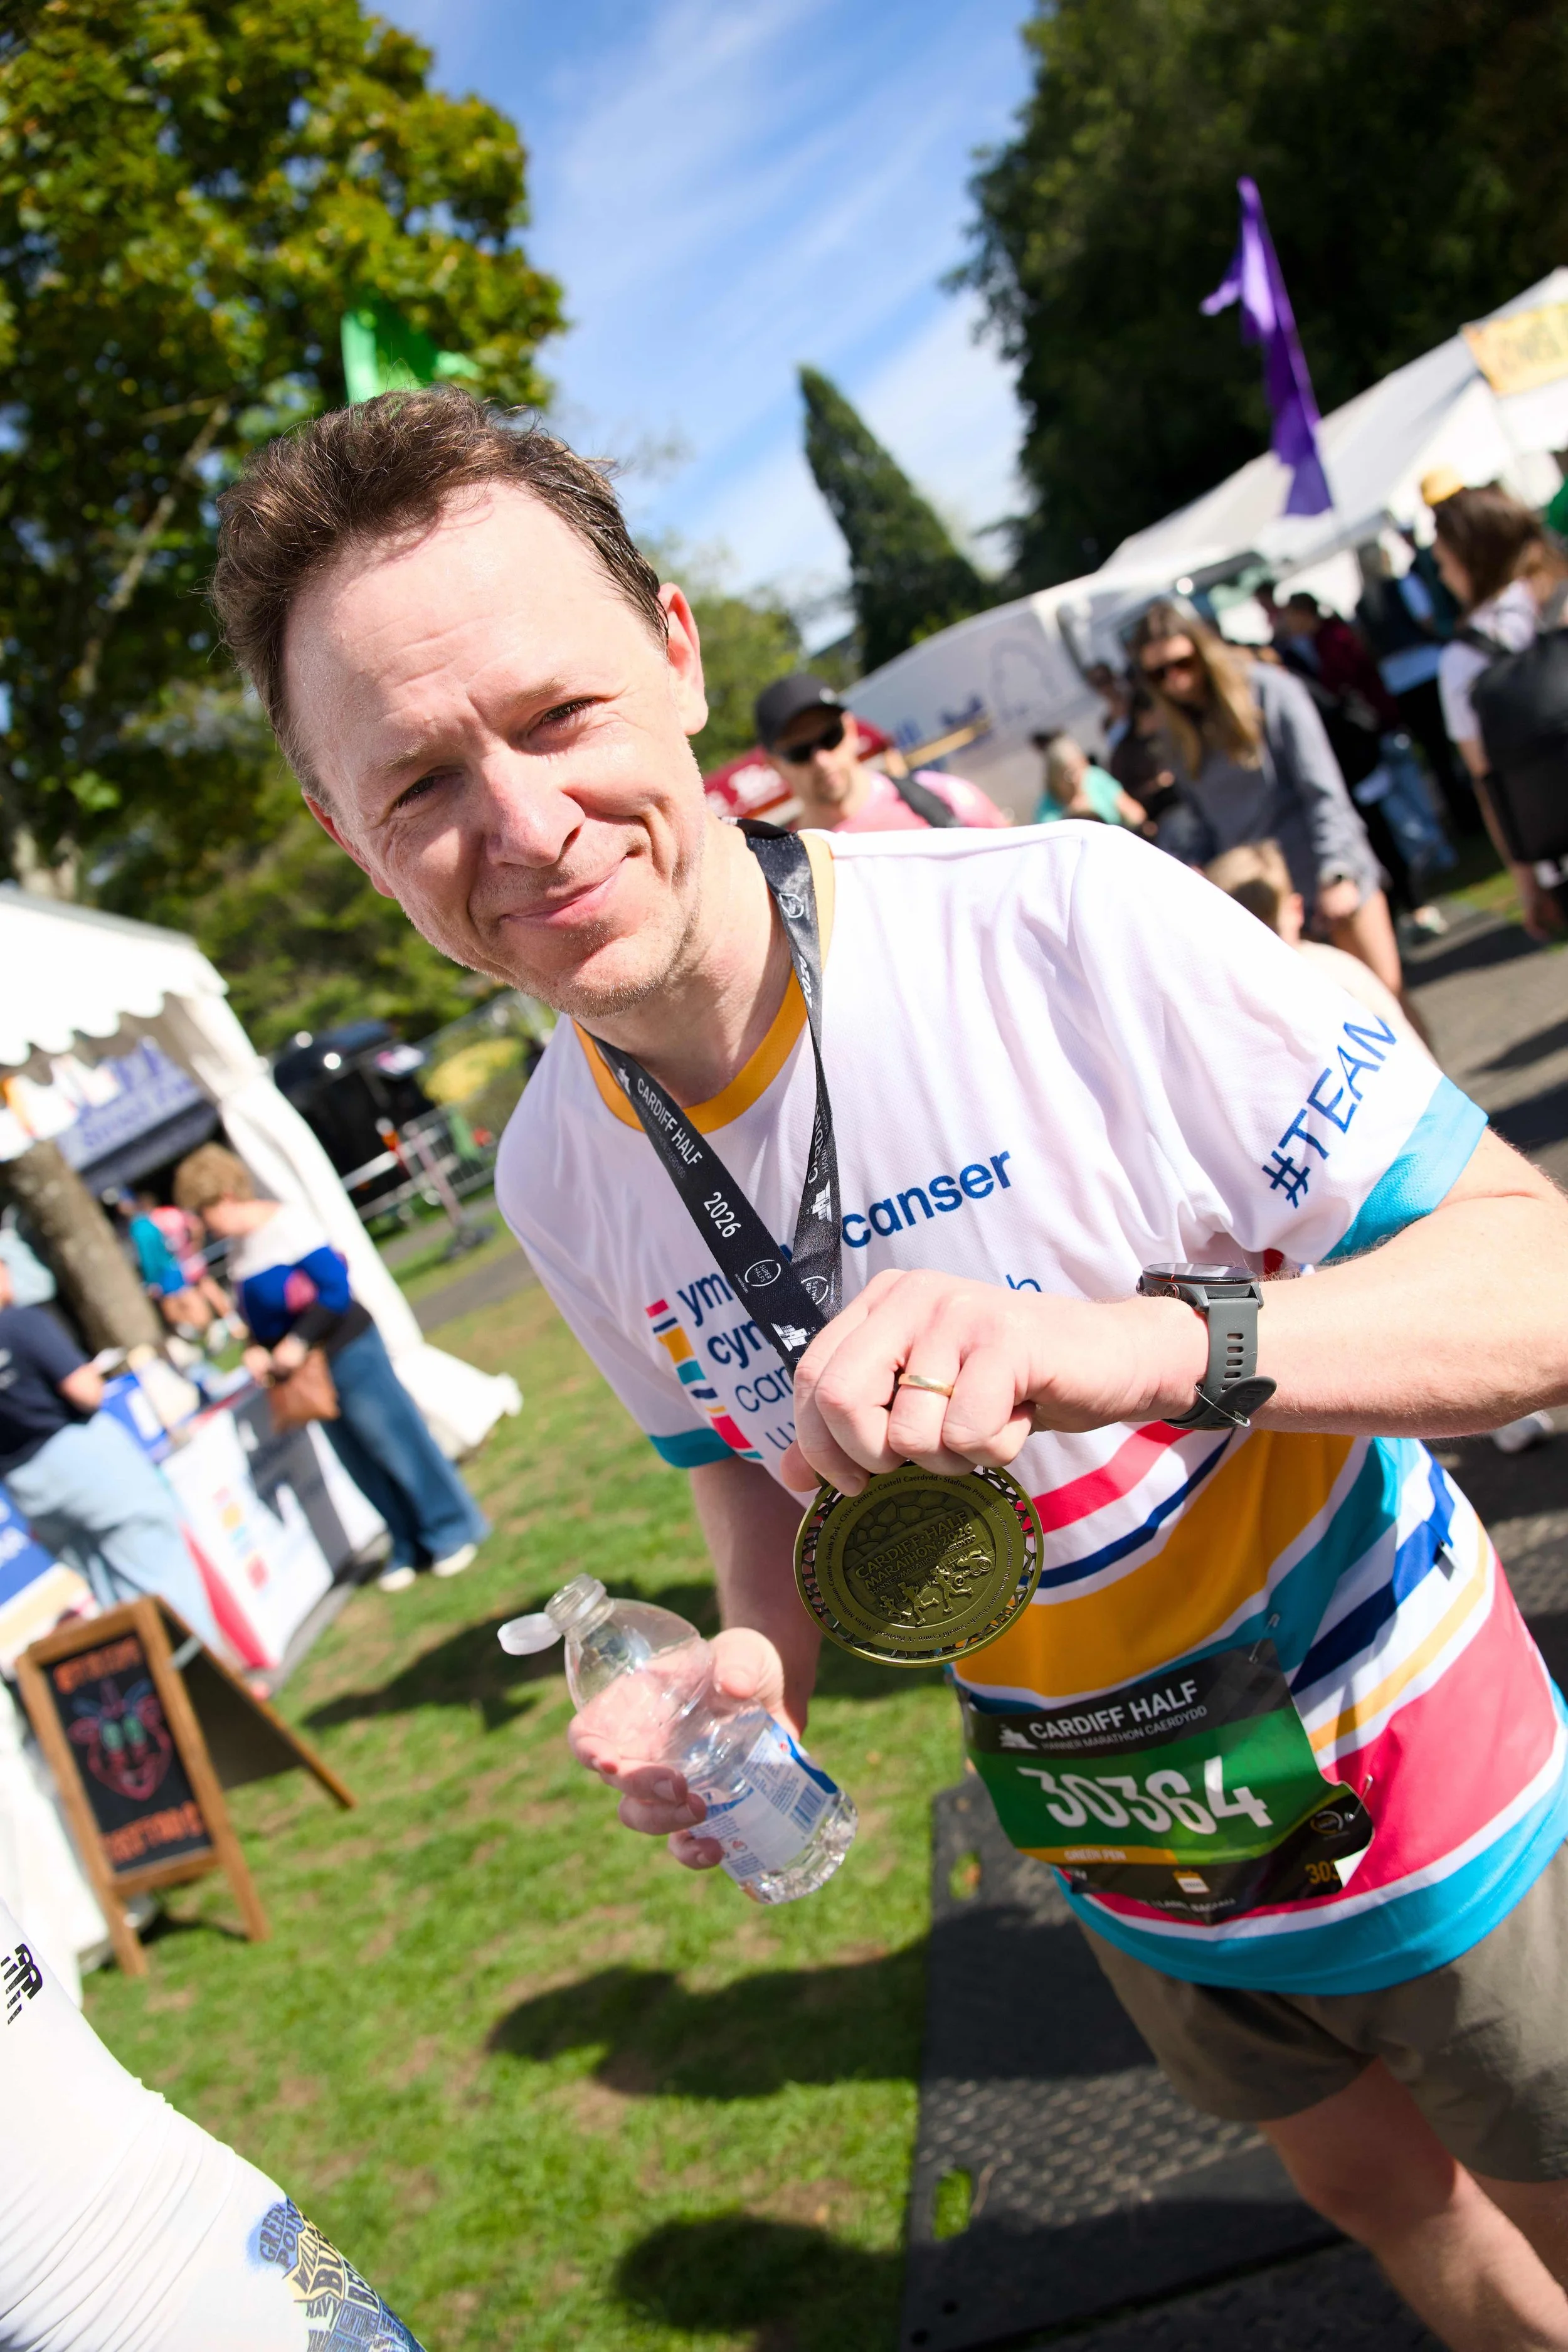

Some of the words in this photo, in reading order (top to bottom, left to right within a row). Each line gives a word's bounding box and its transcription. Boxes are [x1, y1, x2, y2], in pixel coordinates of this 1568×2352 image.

[637, 1078, 678, 1131] CARDIFF
[671, 1127, 703, 1165] HALF
[703, 1192, 742, 1238] 2026
[842, 1150, 1011, 1248] canser
[754, 1268, 766, 1283] HALFS
[760, 1264, 772, 1279] SUPER
[878, 1477, 901, 1490] Castell
[943, 1476, 972, 1491] Stadiwm
[972, 1489, 1001, 1518] Principality
[839, 1508, 854, 1522] Civic
[852, 1490, 874, 1507] Centre
[830, 1526, 840, 1542] Park
[856, 1535, 921, 1578] CARDIFF
[924, 1512, 967, 1540] HALF
[942, 1523, 973, 1547] 2026
[826, 1542, 835, 1560] Roath
[827, 1565, 835, 1586] Centre
[857, 1616, 872, 1631] Wales
[1029, 1706, 1125, 1740] CARDIFF
[1128, 1679, 1198, 1722] HALF
[1083, 1726, 1145, 1748] MARATHON
[1145, 1705, 1208, 1736] CAERDYDD
[1016, 1755, 1274, 1835] 30364
[259, 2202, 287, 2262] GREEN
[306, 2296, 342, 2329] NAVY
